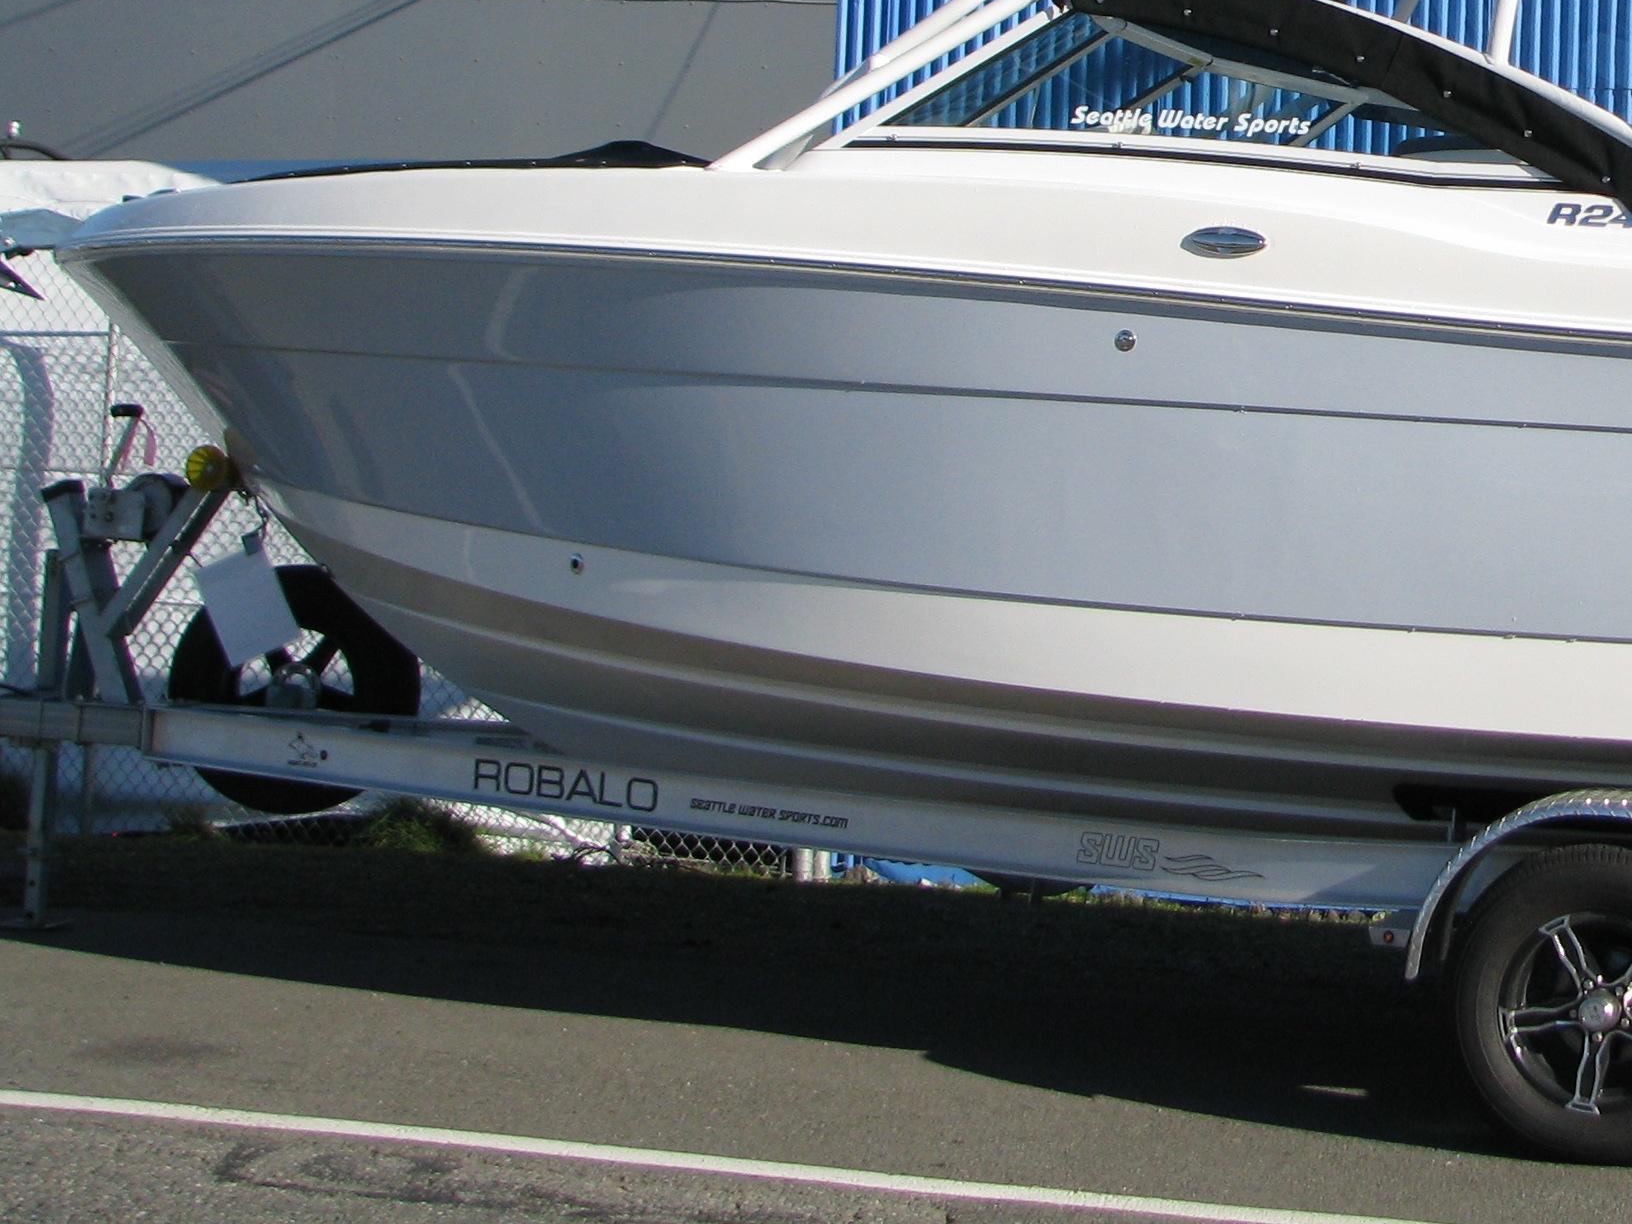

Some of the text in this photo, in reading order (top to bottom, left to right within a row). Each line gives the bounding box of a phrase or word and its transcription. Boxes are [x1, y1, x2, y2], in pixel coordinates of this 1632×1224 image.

[1070, 105, 1312, 137] Seattle Water Sports
[473, 758, 659, 812] ROBALO
[1076, 831, 1160, 872] SWS
